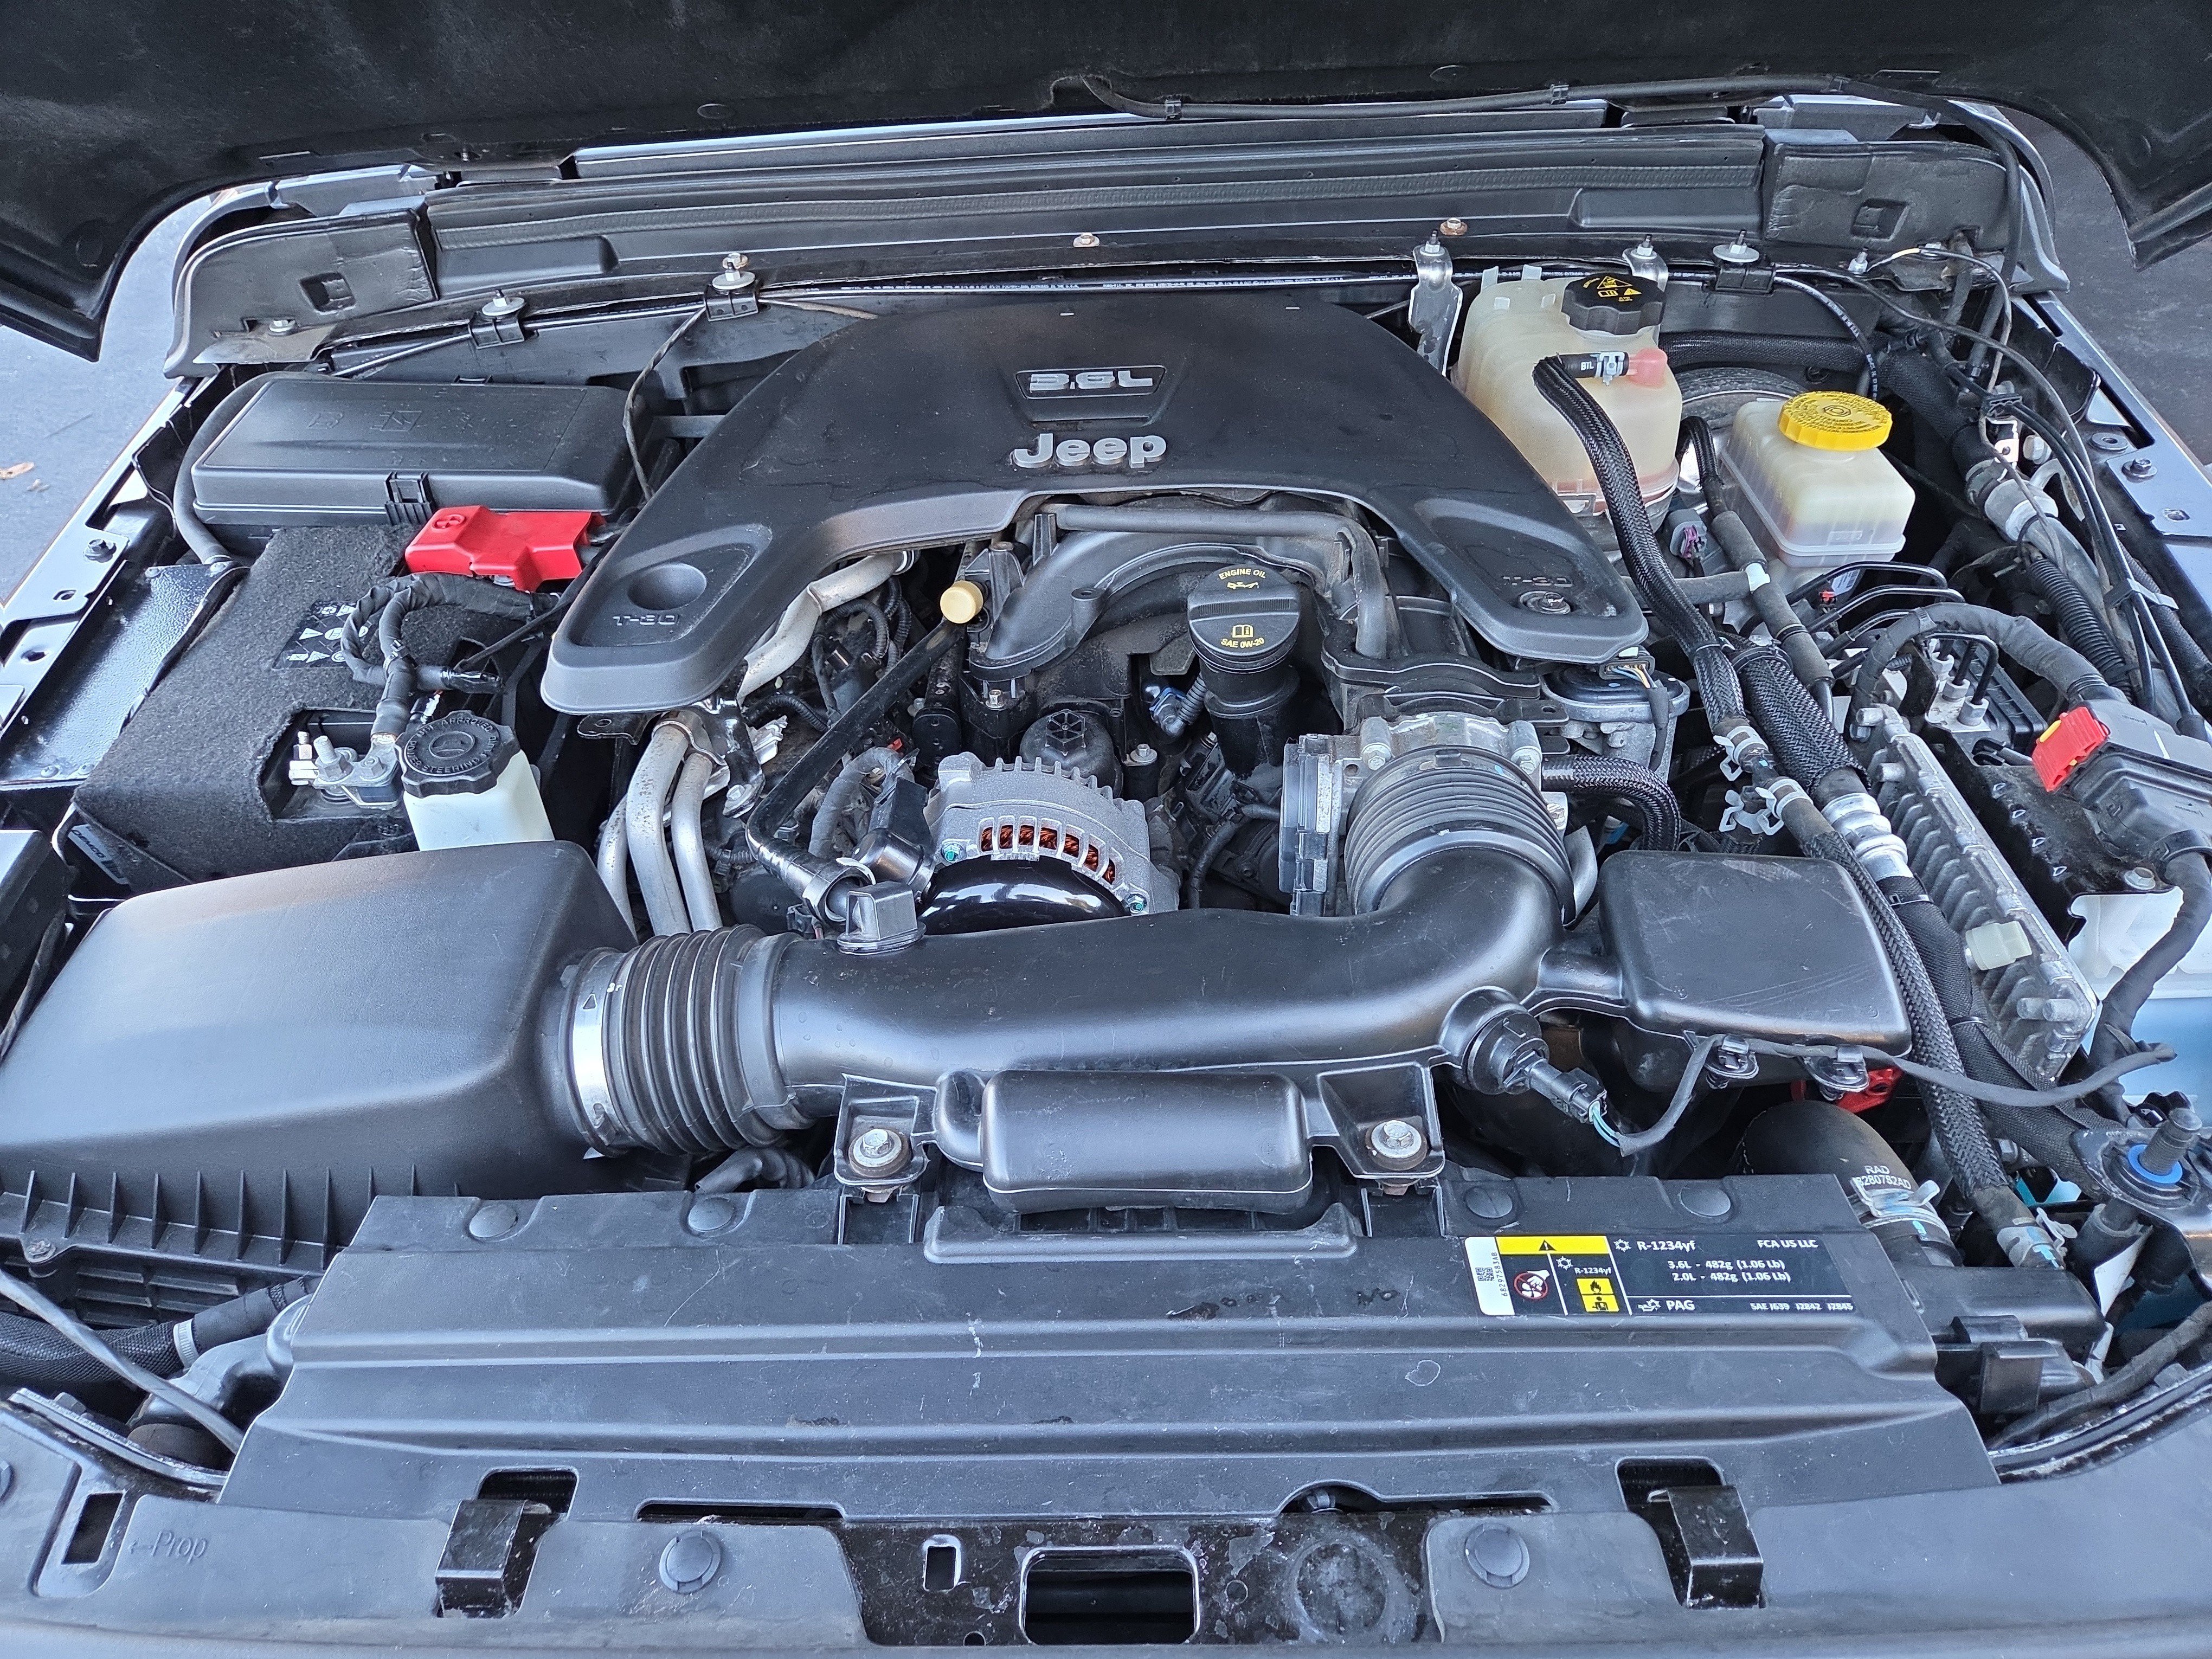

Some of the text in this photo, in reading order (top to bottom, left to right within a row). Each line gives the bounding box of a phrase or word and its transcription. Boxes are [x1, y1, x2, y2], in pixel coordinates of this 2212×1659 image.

[1580, 361, 1594, 371] BTL
[1030, 370, 1153, 391] 3.6L
[1014, 433, 1167, 468] Jeep
[1219, 568, 1266, 580] ENGINE OIL
[1221, 638, 1238, 648] SAE
[441, 717, 493, 732] APPROVED
[422, 757, 480, 774] STEERING
[1864, 1165, 1891, 1175] RAD
[1637, 1240, 1695, 1252] R-1234yf
[1757, 1240, 1818, 1248] FCA US LLC
[1667, 1260, 1692, 1269] 3.6L
[1705, 1260, 1733, 1270] 482g
[1736, 1259, 1764, 1270] (1.06
[1767, 1259, 1785, 1270] Lb)
[1491, 1252, 1508, 1297] 68297583AB
[1672, 1272, 1696, 1282] 2.0L
[1710, 1272, 1738, 1283] 482g
[1741, 1272, 1770, 1282] (1.06
[1772, 1272, 1791, 1282] Lb)
[1666, 1301, 1695, 1310] PAG
[1751, 1303, 1769, 1311] SAE
[151, 1530, 207, 1564] Prop
